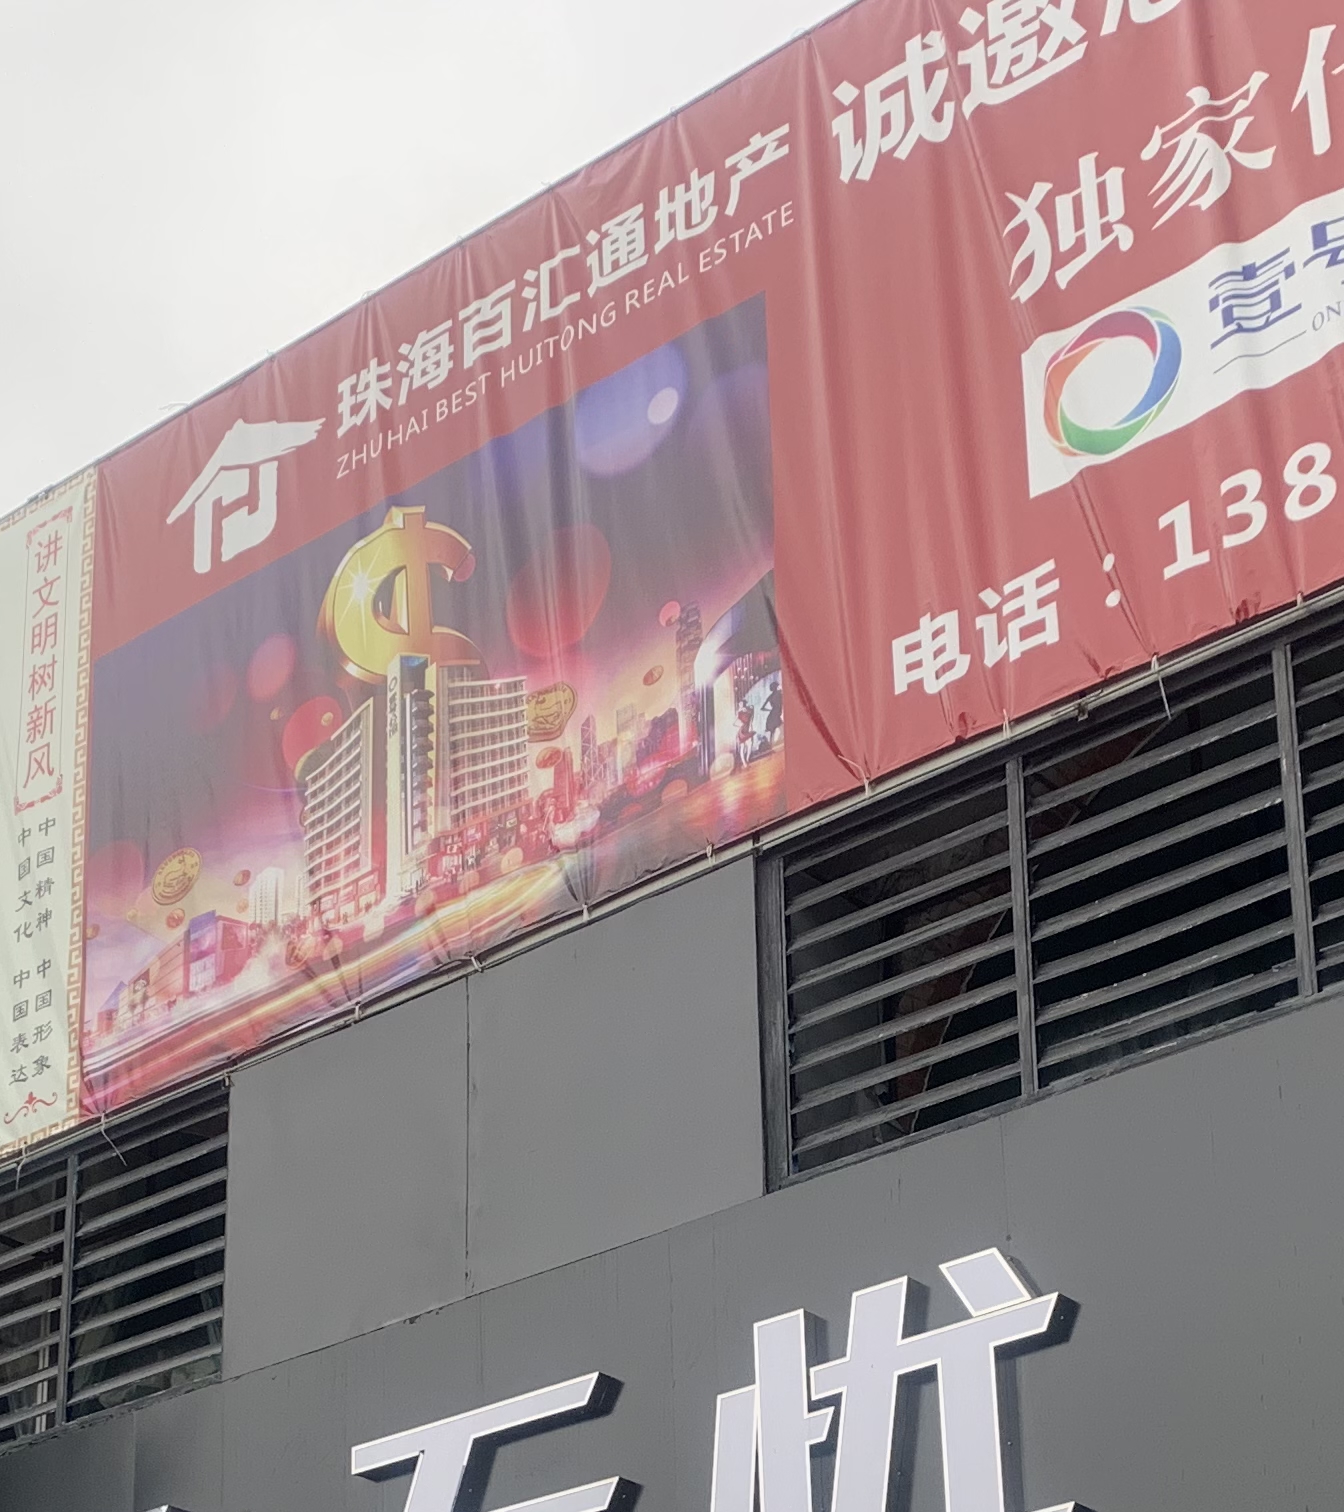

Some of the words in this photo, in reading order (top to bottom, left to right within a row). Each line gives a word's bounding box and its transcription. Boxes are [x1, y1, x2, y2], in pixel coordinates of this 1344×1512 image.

[831, 0, 1184, 186] 诚邀
[336, 122, 791, 439] 珠海百汇通地产
[336, 412, 429, 480] ZHUHAI
[434, 372, 489, 426] BEST
[499, 303, 618, 388] HUITONG
[624, 265, 691, 314] REAL
[697, 200, 796, 275] ESTATE
[22, 528, 63, 788] 讲文明树新风
[13, 826, 34, 943] 中国文化
[34, 816, 57, 932] 中国精神
[9, 968, 31, 1086] 中国表达
[30, 958, 53, 1079] 中国形象
